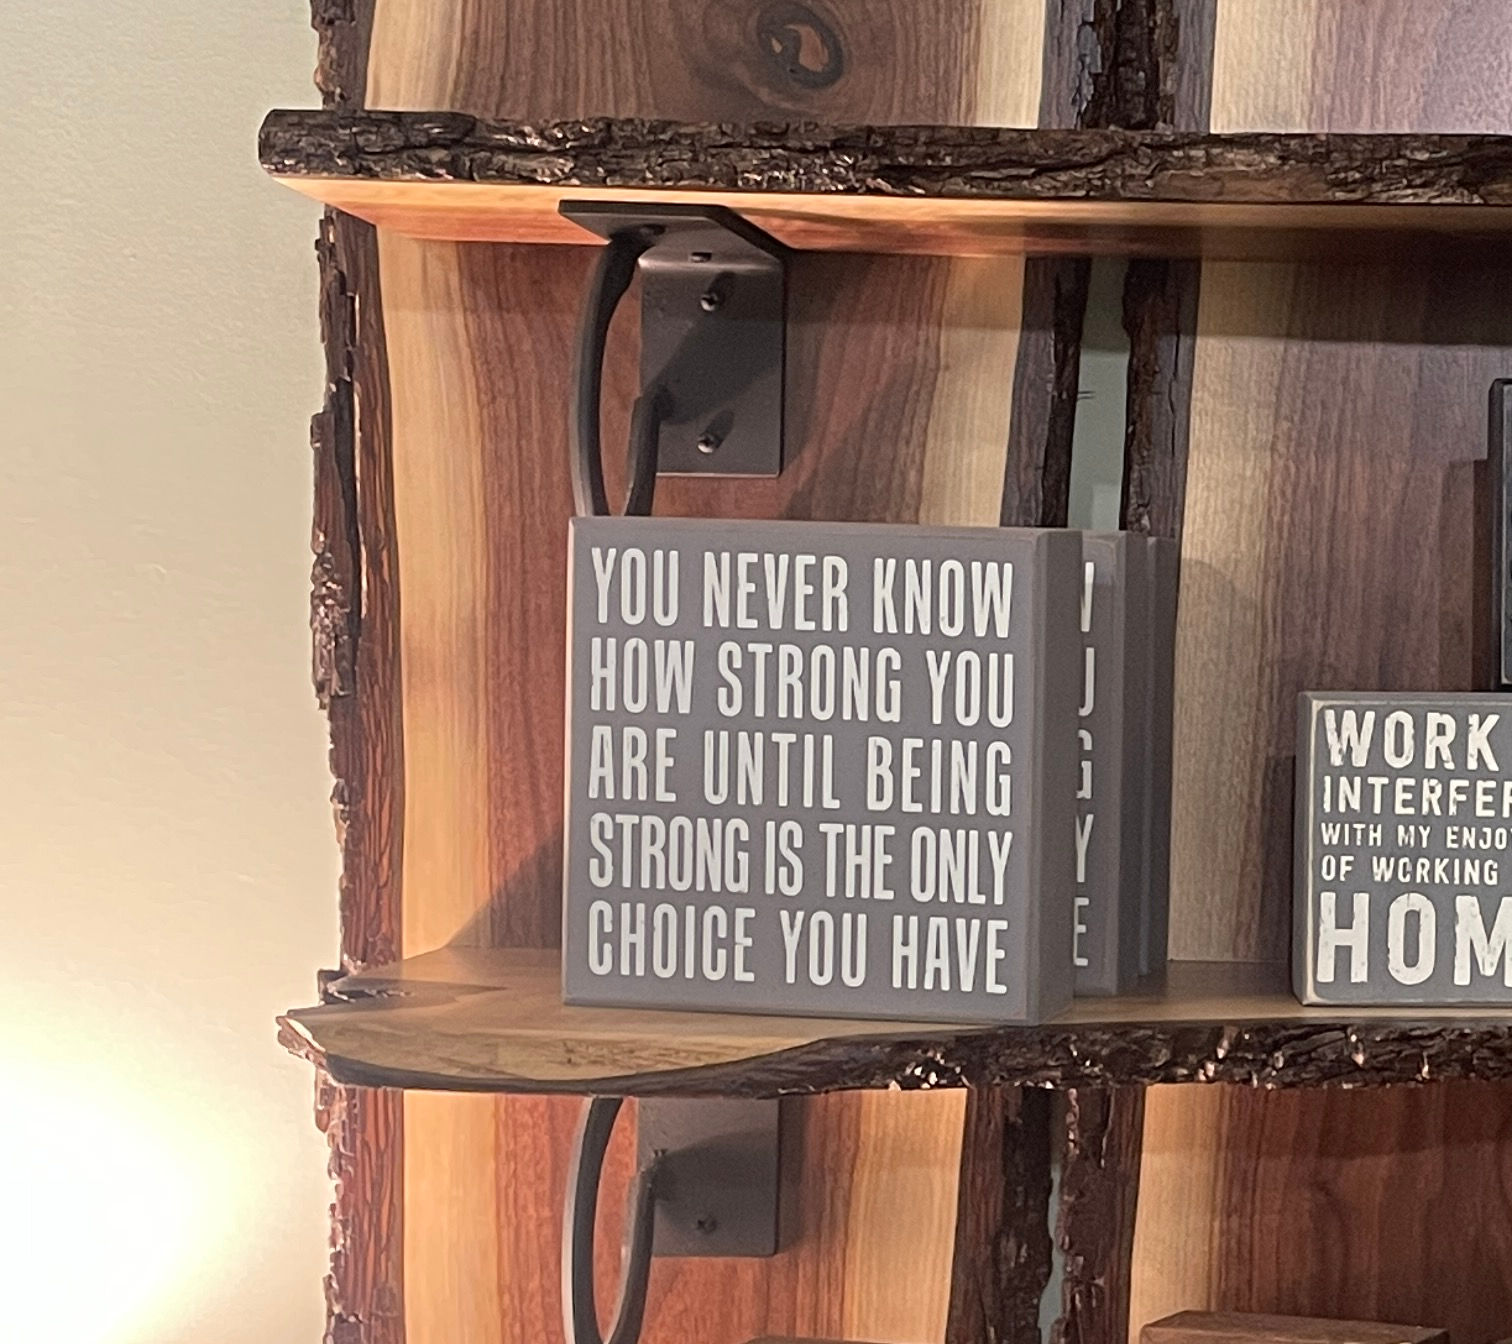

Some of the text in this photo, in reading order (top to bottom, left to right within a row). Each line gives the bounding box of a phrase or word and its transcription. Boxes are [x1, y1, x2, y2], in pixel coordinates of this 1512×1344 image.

[591, 548, 679, 626] YOU
[703, 552, 848, 632] NEVER
[874, 558, 1013, 638] KNOW
[590, 638, 694, 715] HOW
[718, 642, 901, 723] STRONG
[926, 650, 1014, 728] YOU
[589, 726, 677, 803] ARE
[704, 730, 840, 809] UNTIL
[867, 736, 1011, 817] BEING
[1325, 710, 1500, 771] WORK
[590, 813, 749, 894] STRONG
[765, 820, 802, 896] IS
[819, 823, 895, 901] THE
[910, 826, 1012, 906] ONLY
[1321, 823, 1382, 846] WITH
[1398, 825, 1431, 848] MY
[1321, 855, 1354, 881] OF
[1373, 856, 1498, 885] WORKING
[589, 901, 755, 983] CHOICE
[780, 910, 866, 986] YOU
[893, 915, 1008, 994] HAVE
